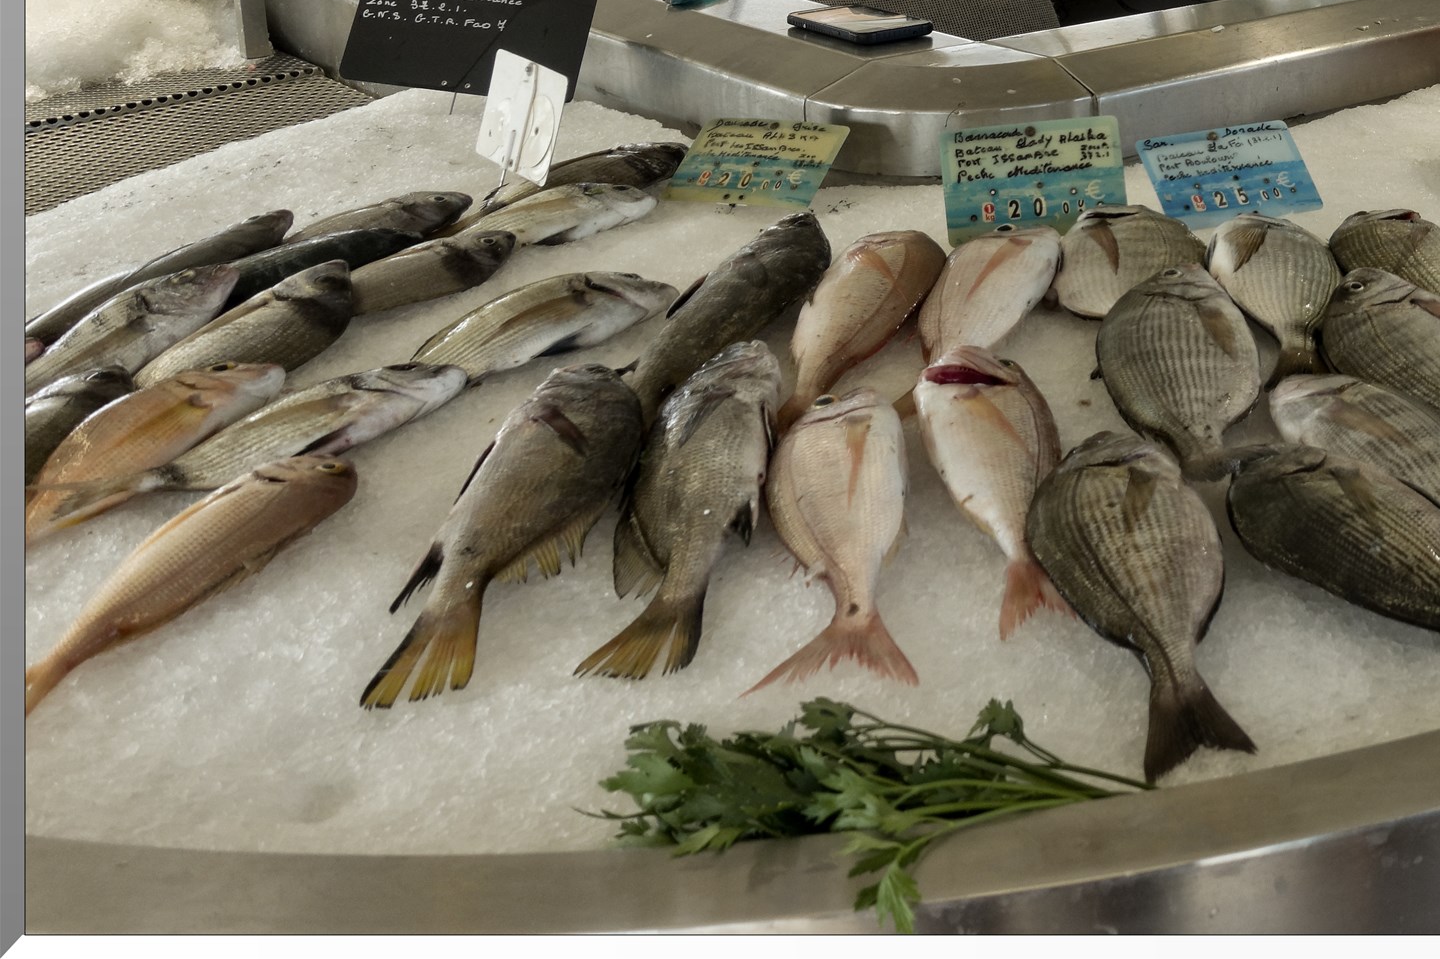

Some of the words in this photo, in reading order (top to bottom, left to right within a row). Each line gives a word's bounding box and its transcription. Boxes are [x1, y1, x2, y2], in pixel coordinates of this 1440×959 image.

[464, 18, 492, 29] Fao
[1276, 171, 1296, 188] €
[1084, 179, 1106, 200] €
